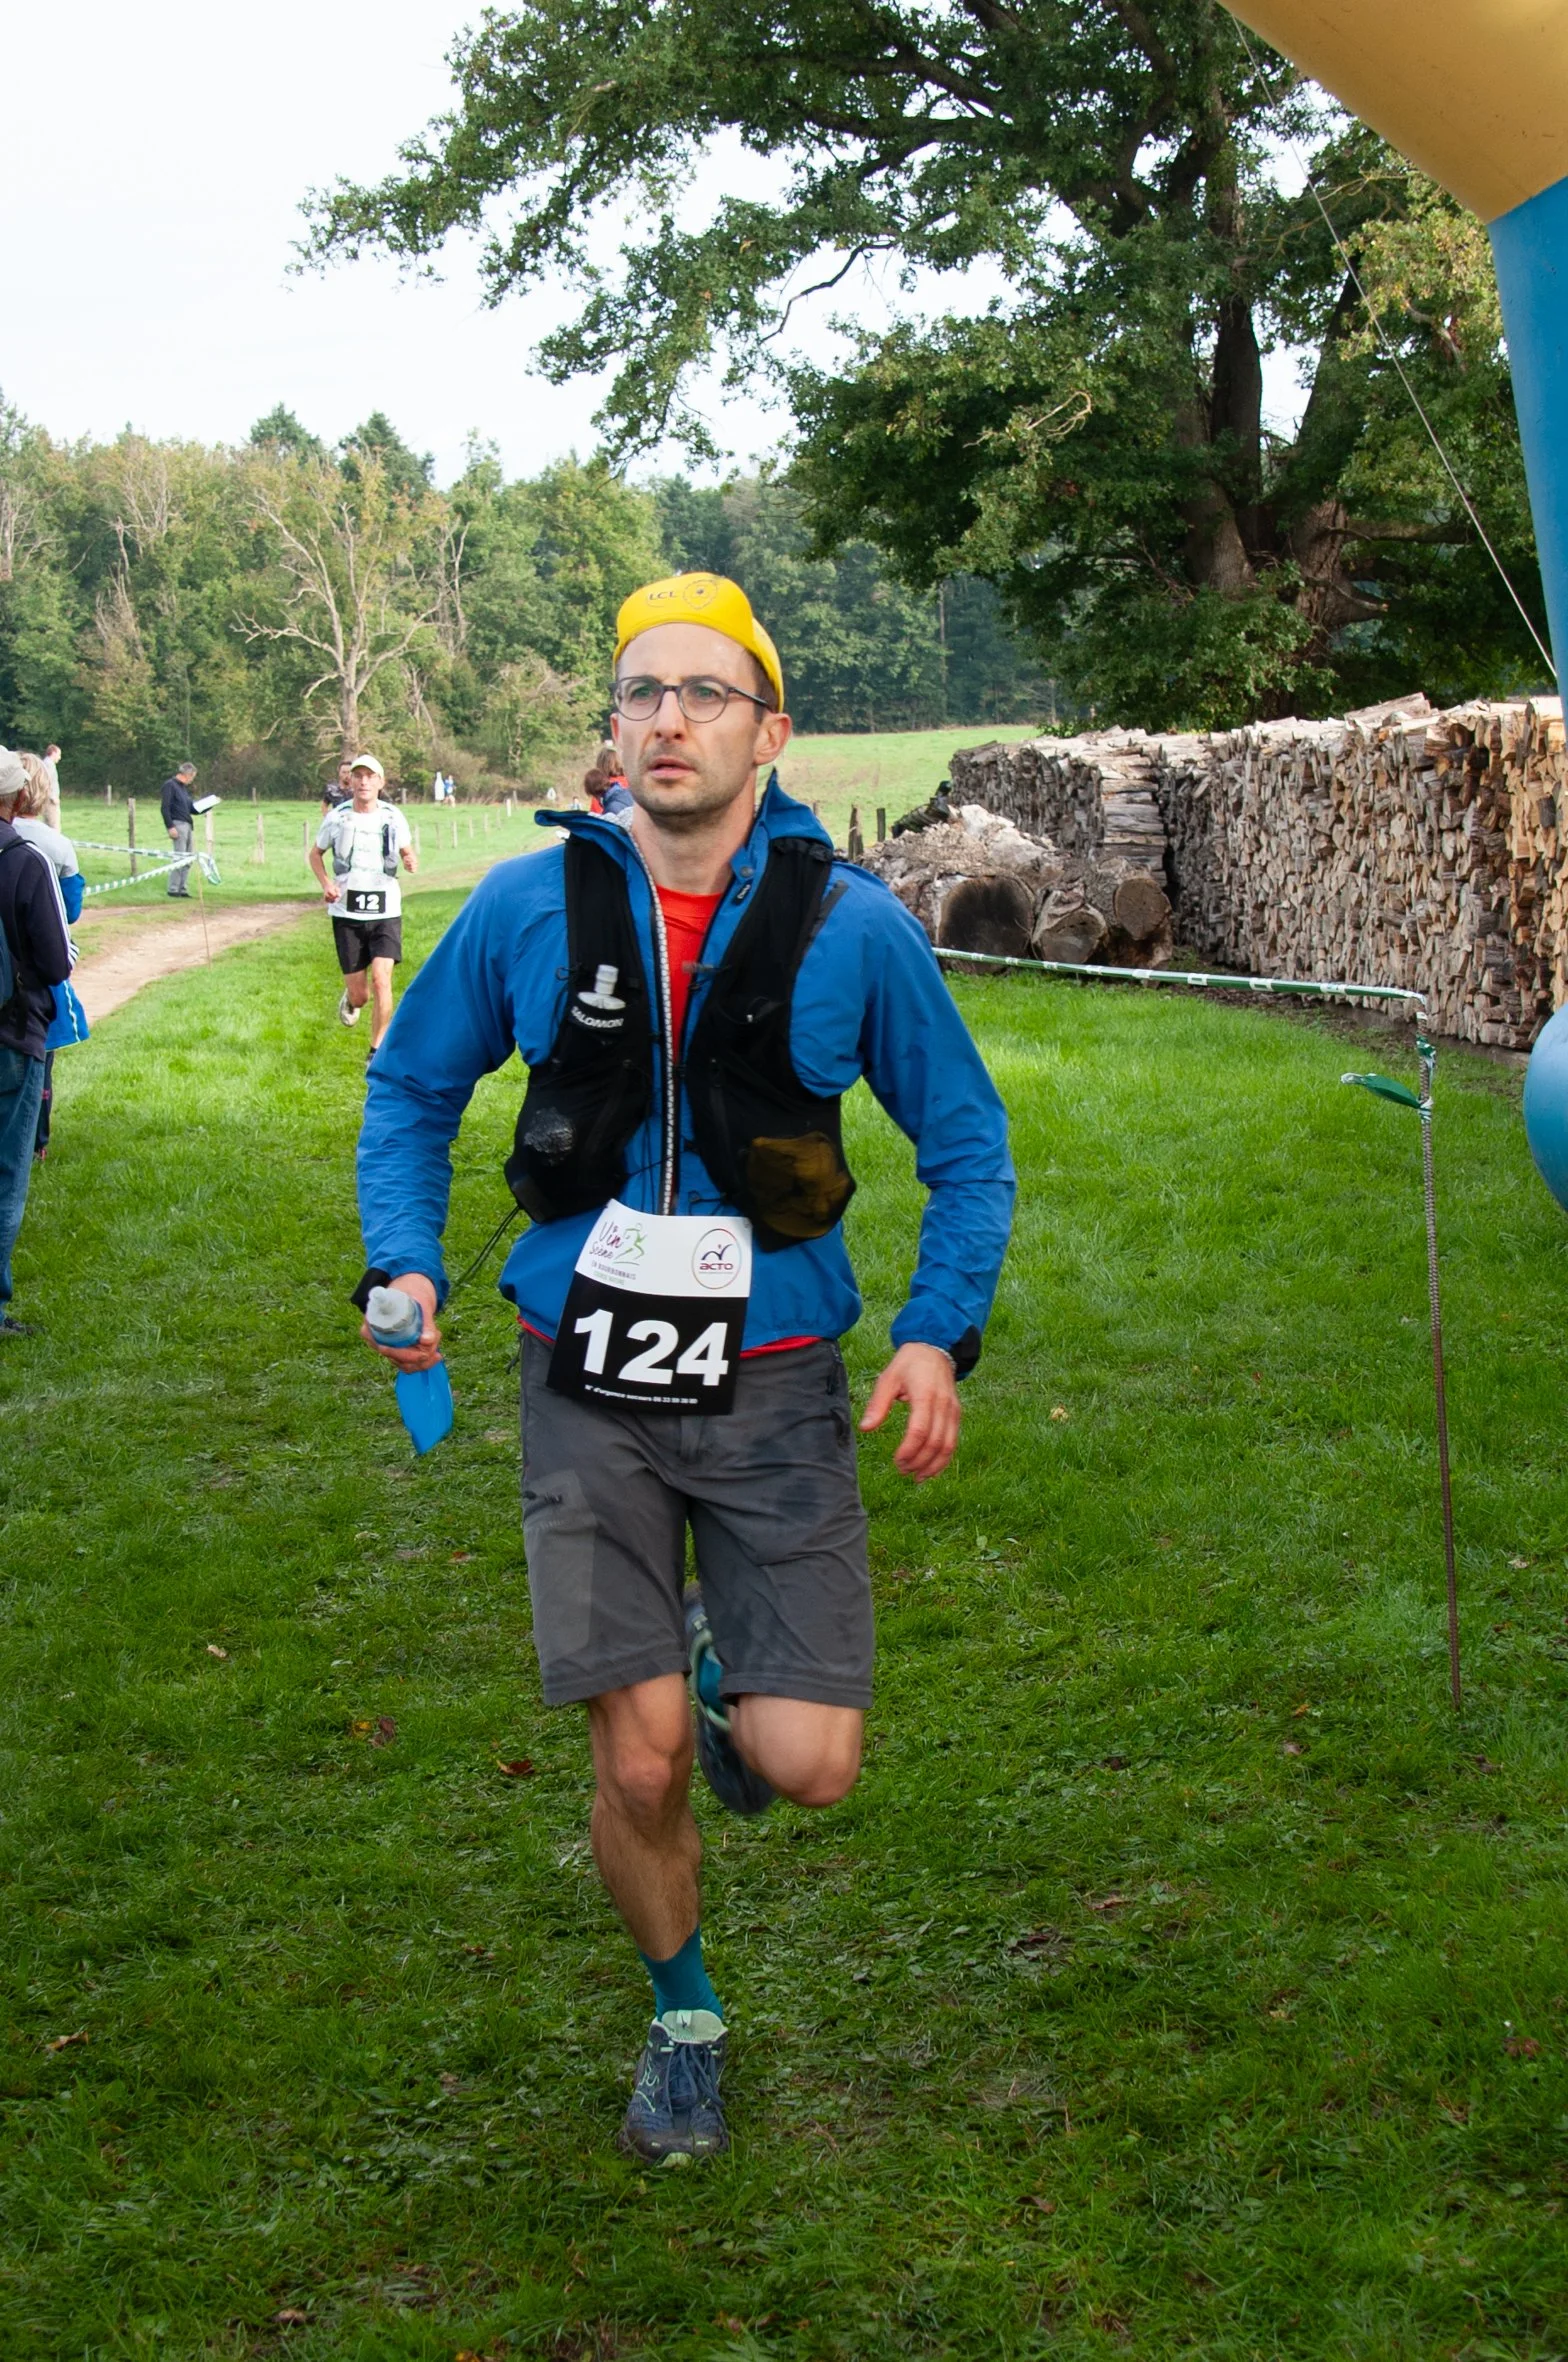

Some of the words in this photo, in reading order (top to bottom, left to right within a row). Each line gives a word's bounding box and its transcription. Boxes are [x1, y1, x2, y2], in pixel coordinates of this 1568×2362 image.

[355, 894, 380, 910] 12
[571, 1005, 625, 1028] SALOMON
[599, 1221, 624, 1249] Vin
[574, 1308, 729, 1386] 124
